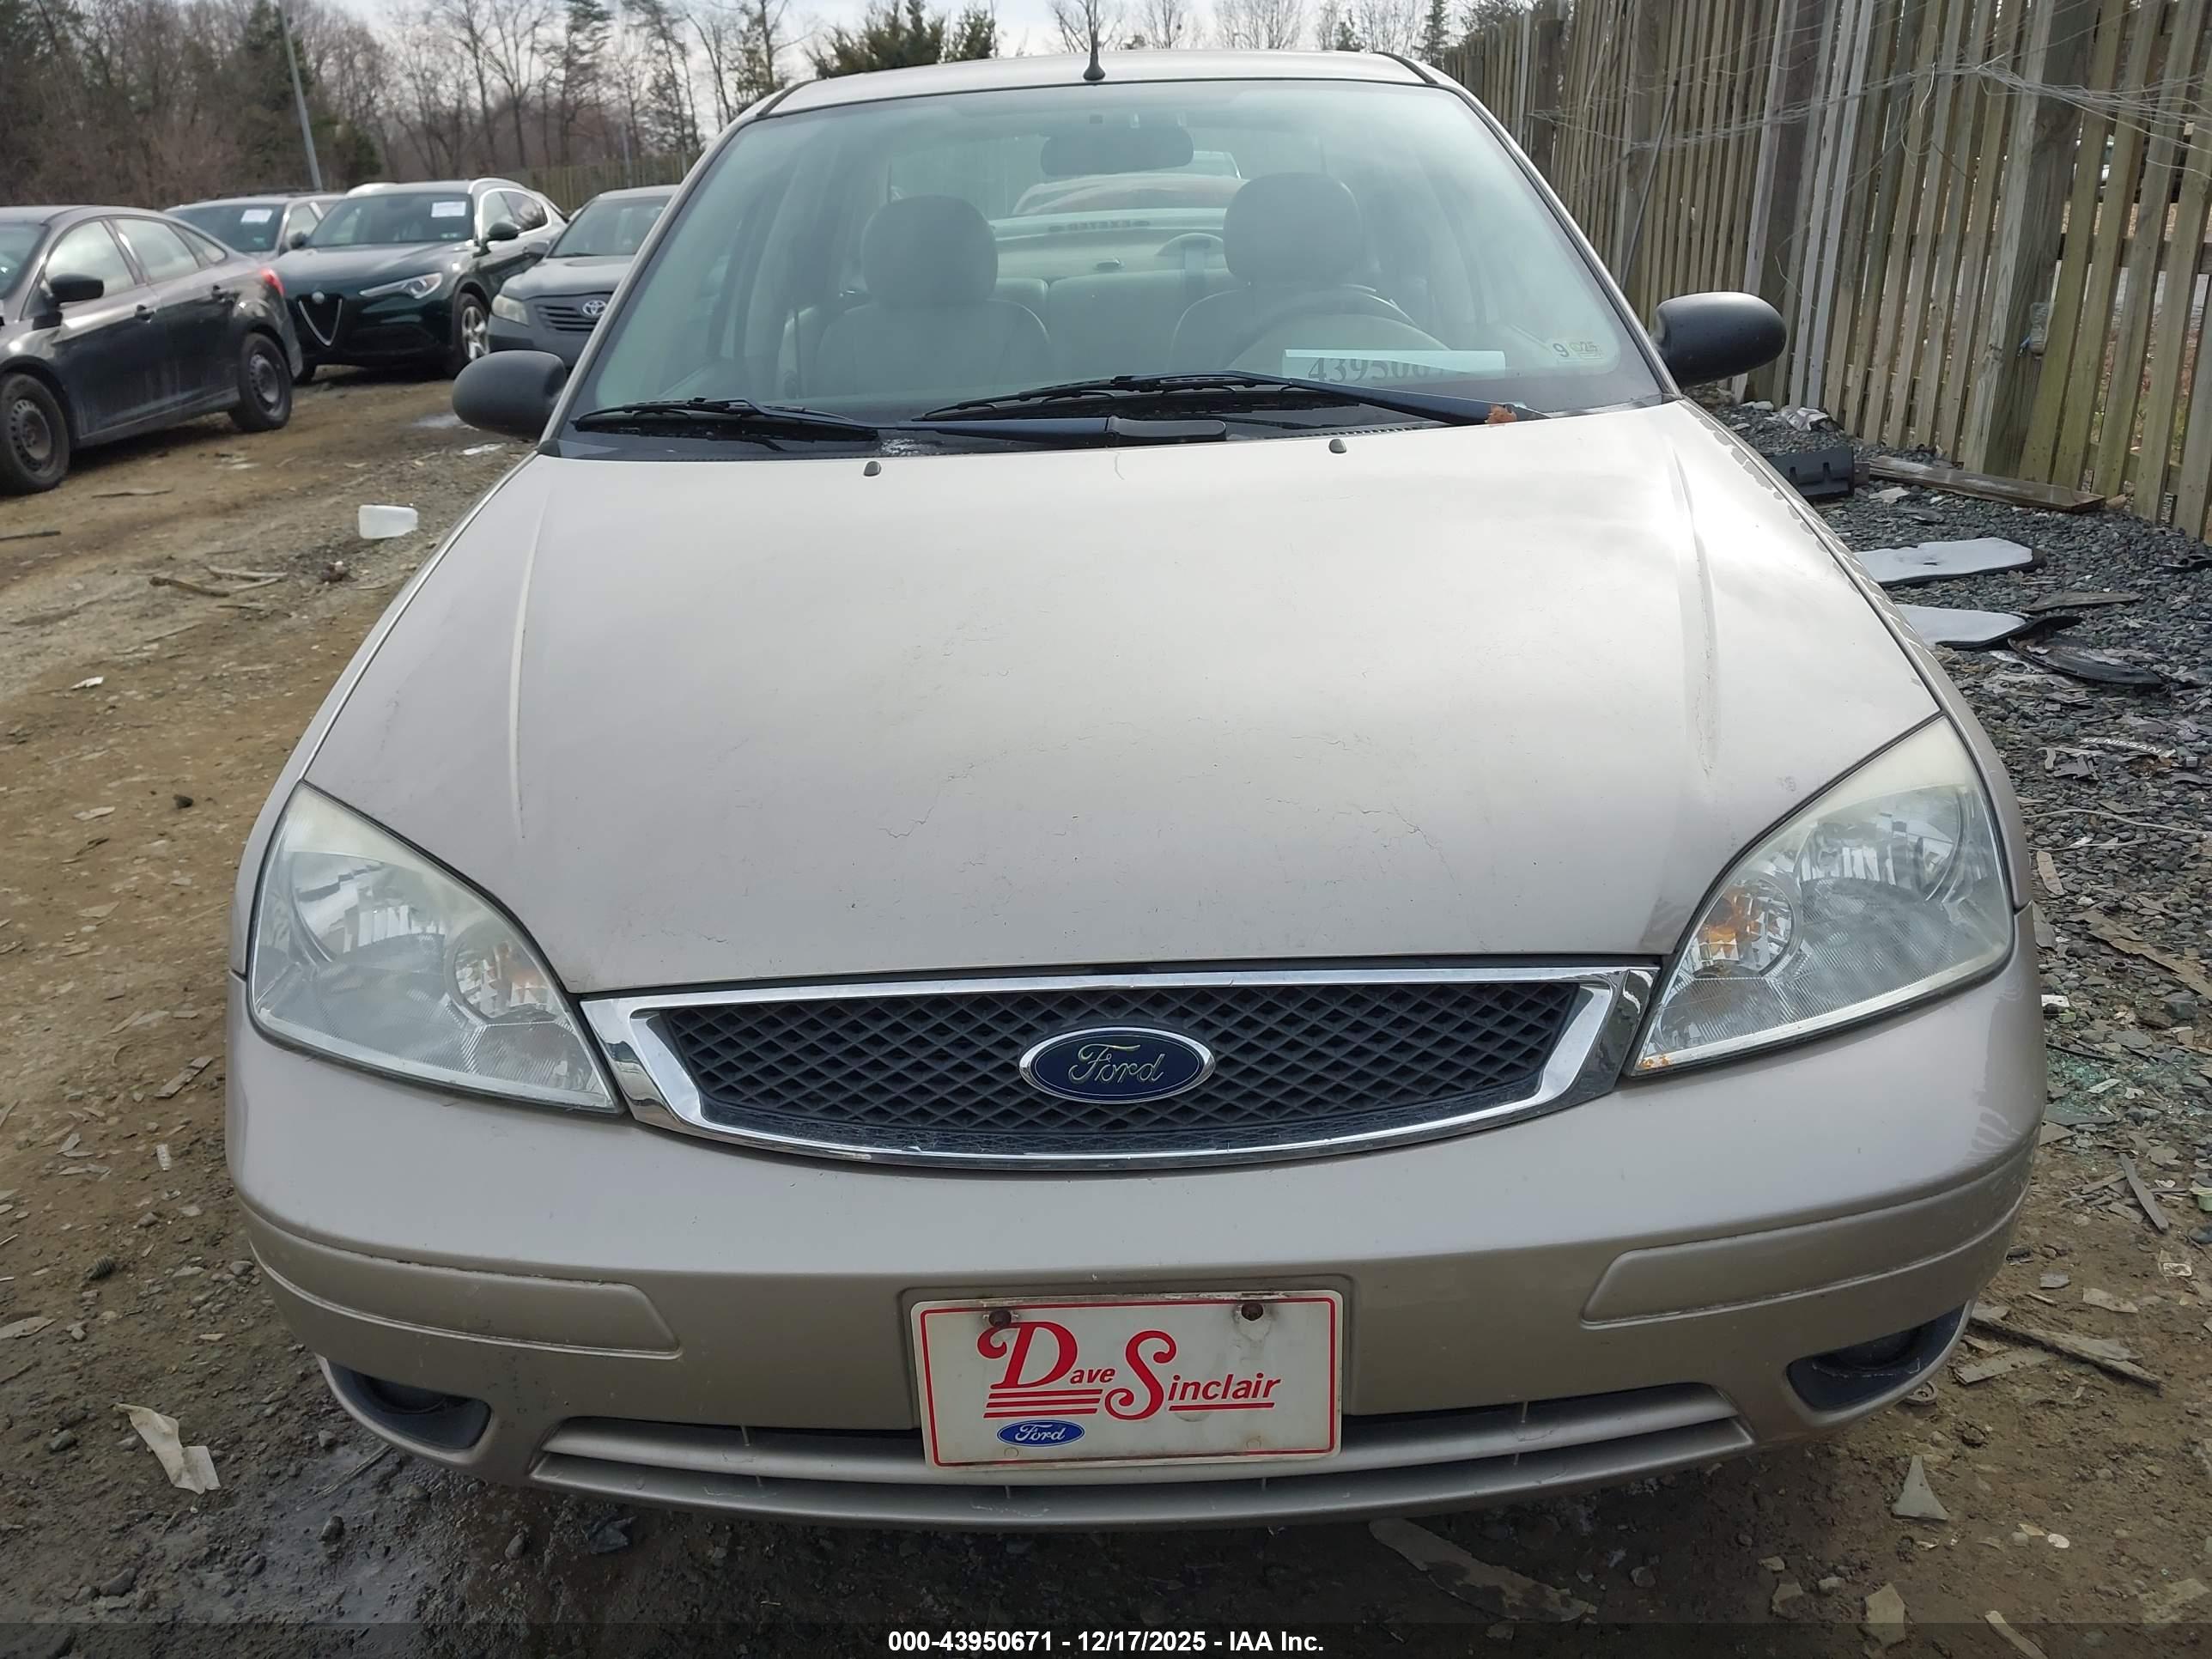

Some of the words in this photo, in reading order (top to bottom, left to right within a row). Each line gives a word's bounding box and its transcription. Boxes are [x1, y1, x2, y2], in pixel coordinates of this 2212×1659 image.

[1553, 343, 1570, 358] 9
[1068, 1042, 1165, 1084] Ford
[977, 1321, 1115, 1390] Dave
[1104, 1329, 1282, 1420] Sinclair
[1014, 1424, 1066, 1442] Ford
